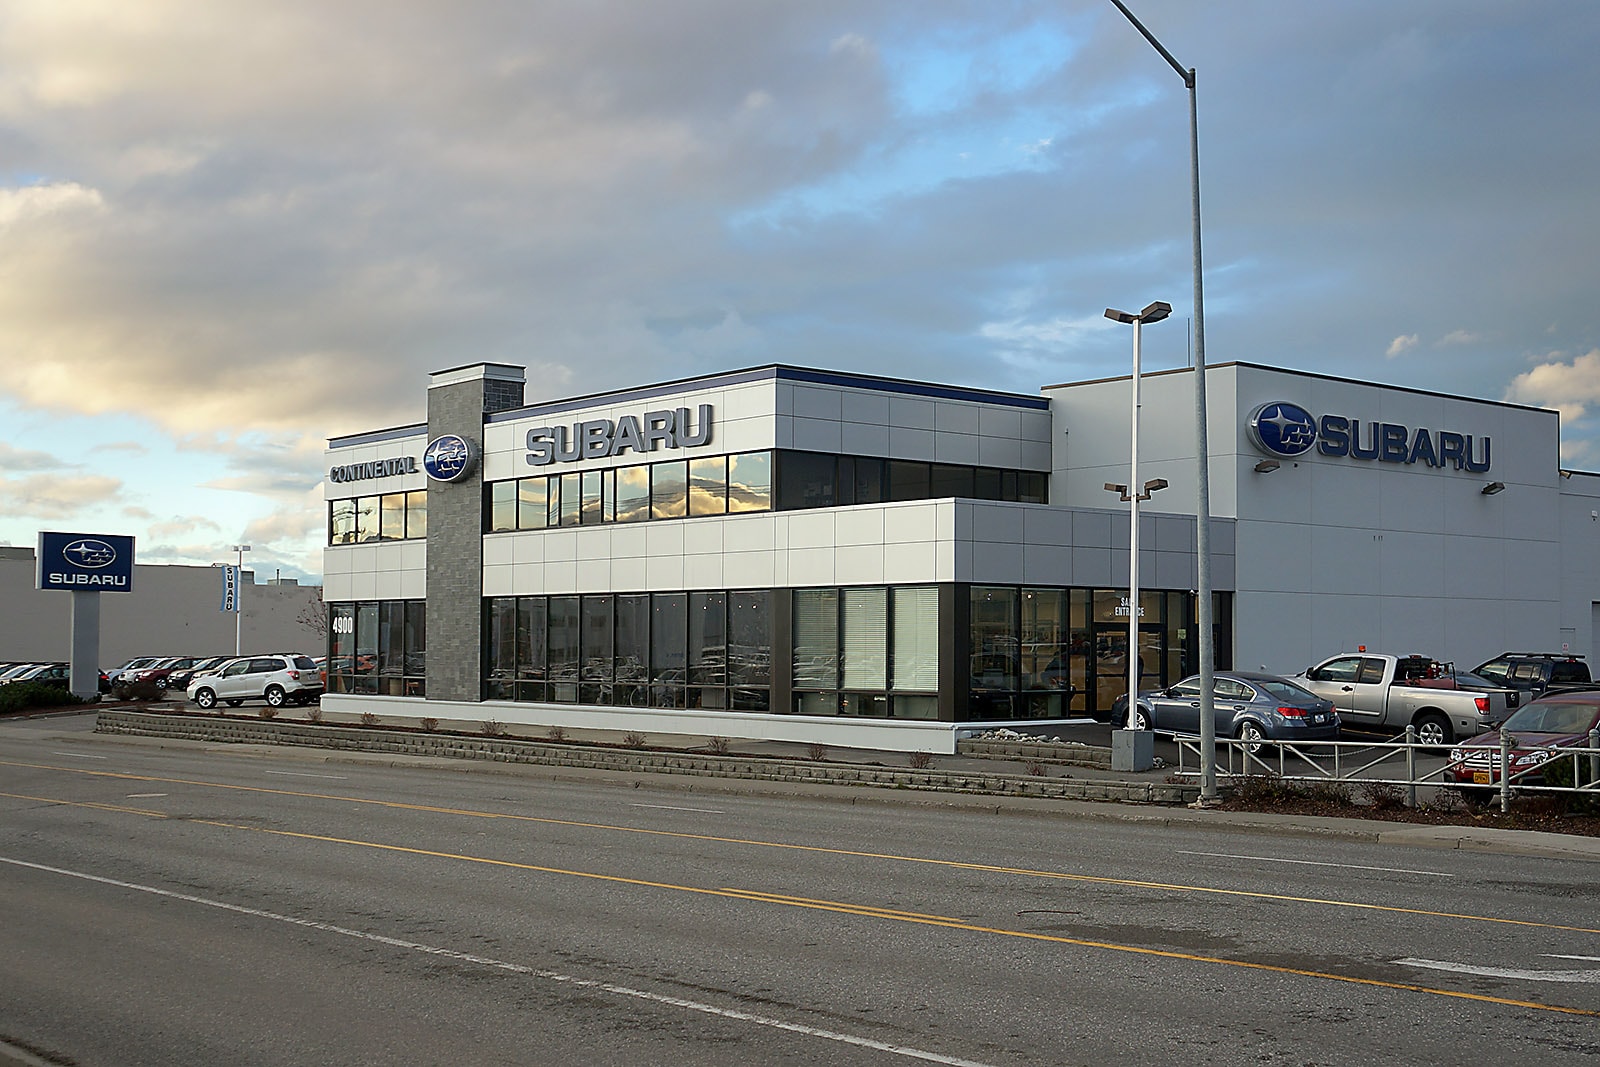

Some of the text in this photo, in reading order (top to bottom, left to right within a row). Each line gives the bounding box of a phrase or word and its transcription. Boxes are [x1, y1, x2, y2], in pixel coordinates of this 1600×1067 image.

[526, 404, 712, 466] SUBARU
[1317, 414, 1492, 473] SUBARU
[330, 456, 418, 482] CONTINENTAL
[49, 573, 126, 586] SUBARU
[1114, 606, 1145, 616] ENTRCE
[332, 616, 353, 633] 4900
